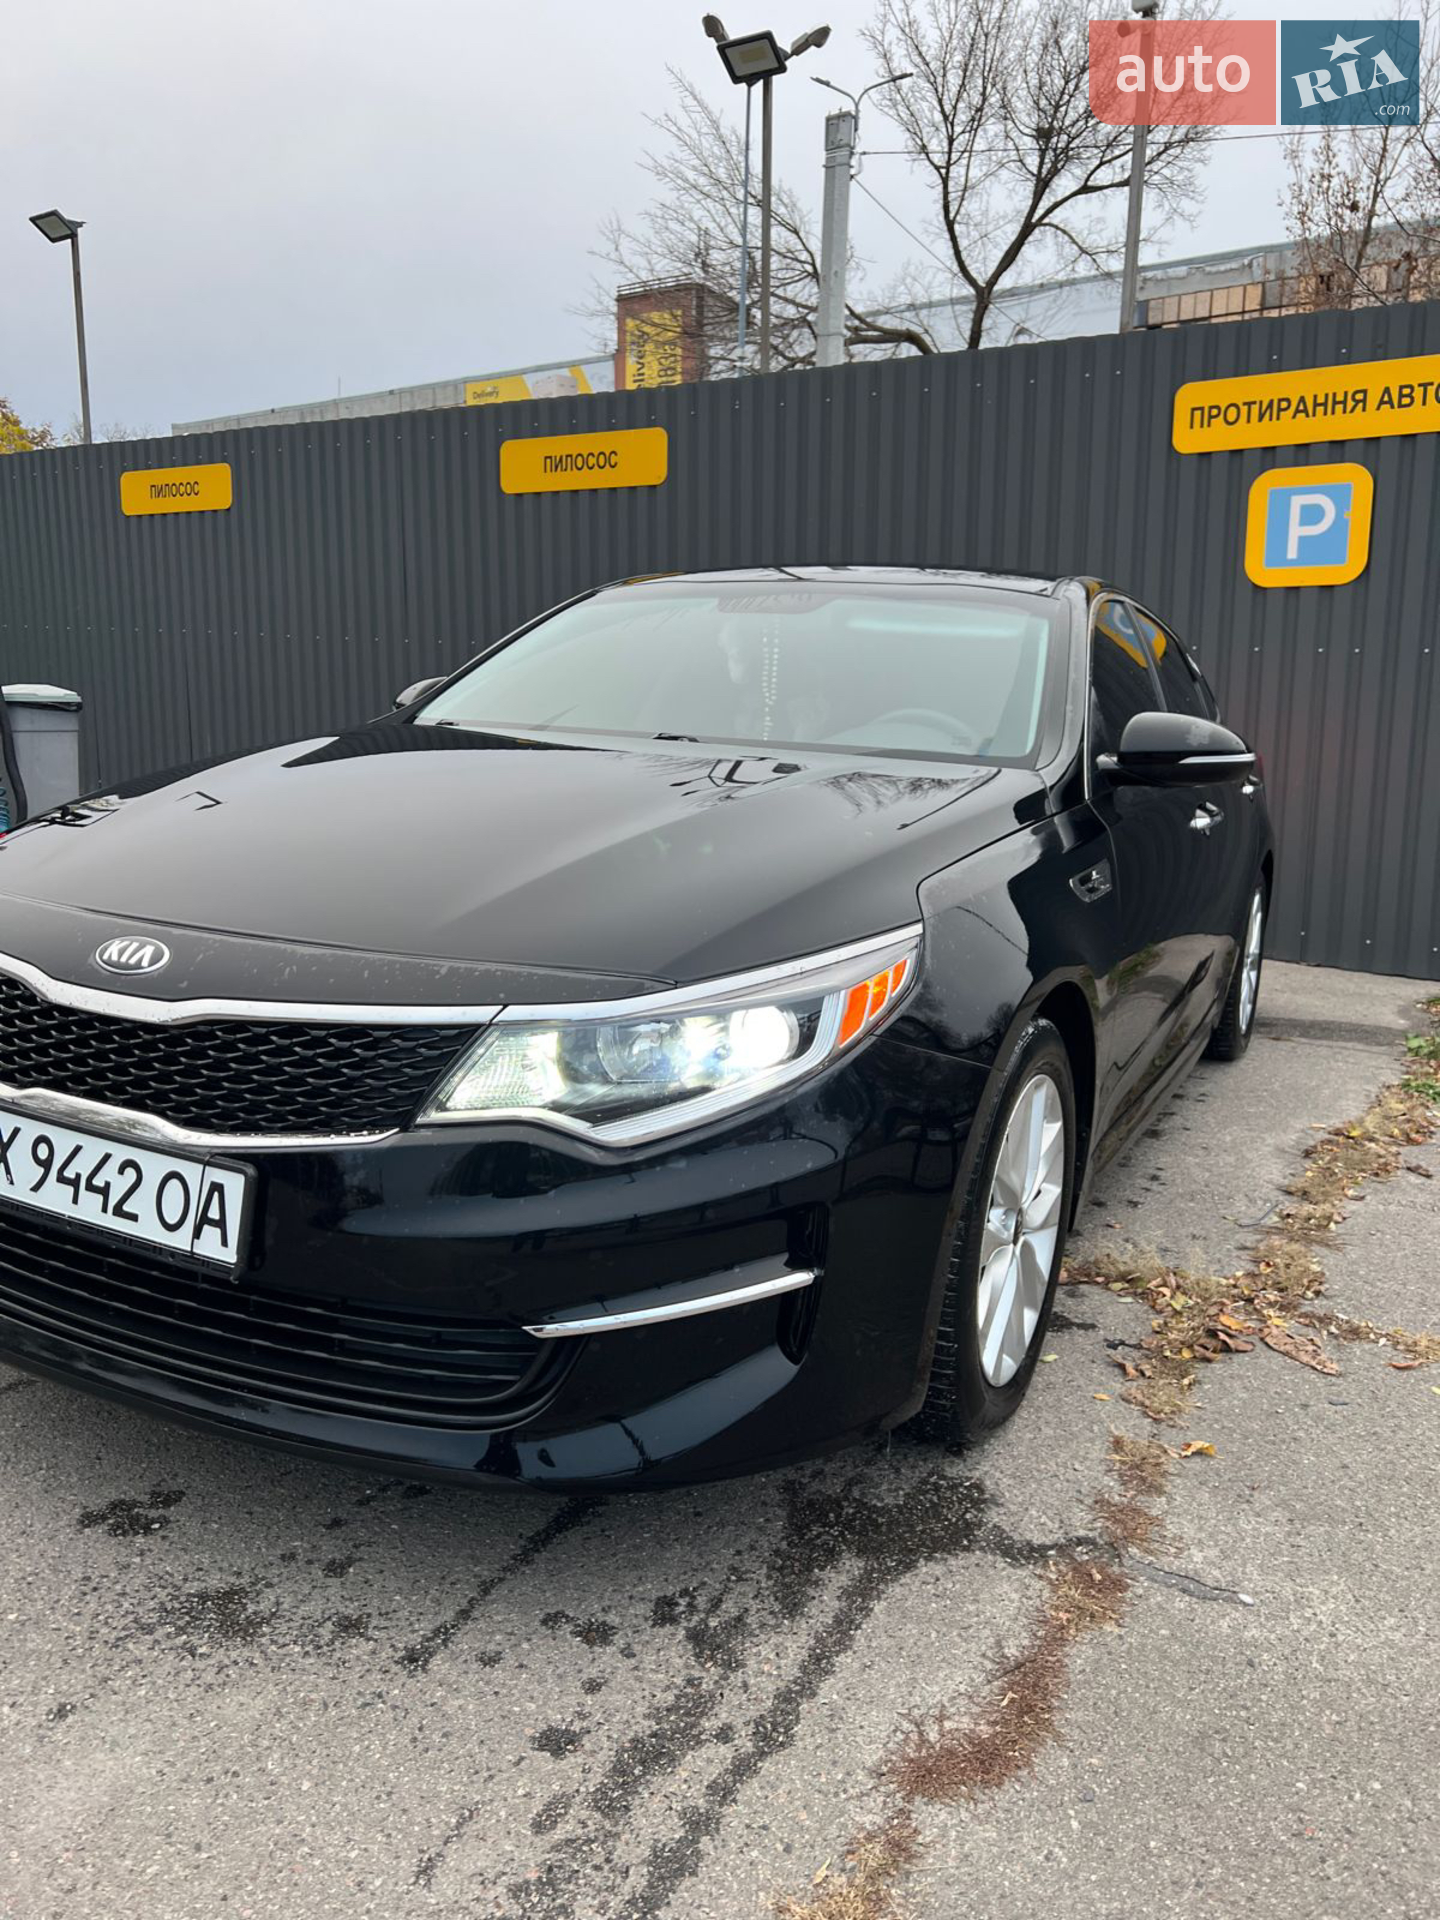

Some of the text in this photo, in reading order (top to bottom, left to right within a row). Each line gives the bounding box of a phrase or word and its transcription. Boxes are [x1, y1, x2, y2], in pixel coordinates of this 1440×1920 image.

[1189, 388, 1368, 429] ПРОТИРАННЯ
[543, 450, 618, 473] ПИЛОСОС
[149, 481, 200, 499] ПИЛОСОС
[1286, 493, 1337, 560] P
[102, 940, 156, 968] KIA
[30, 1134, 144, 1223] 9442
[155, 1170, 229, 1249] OA
